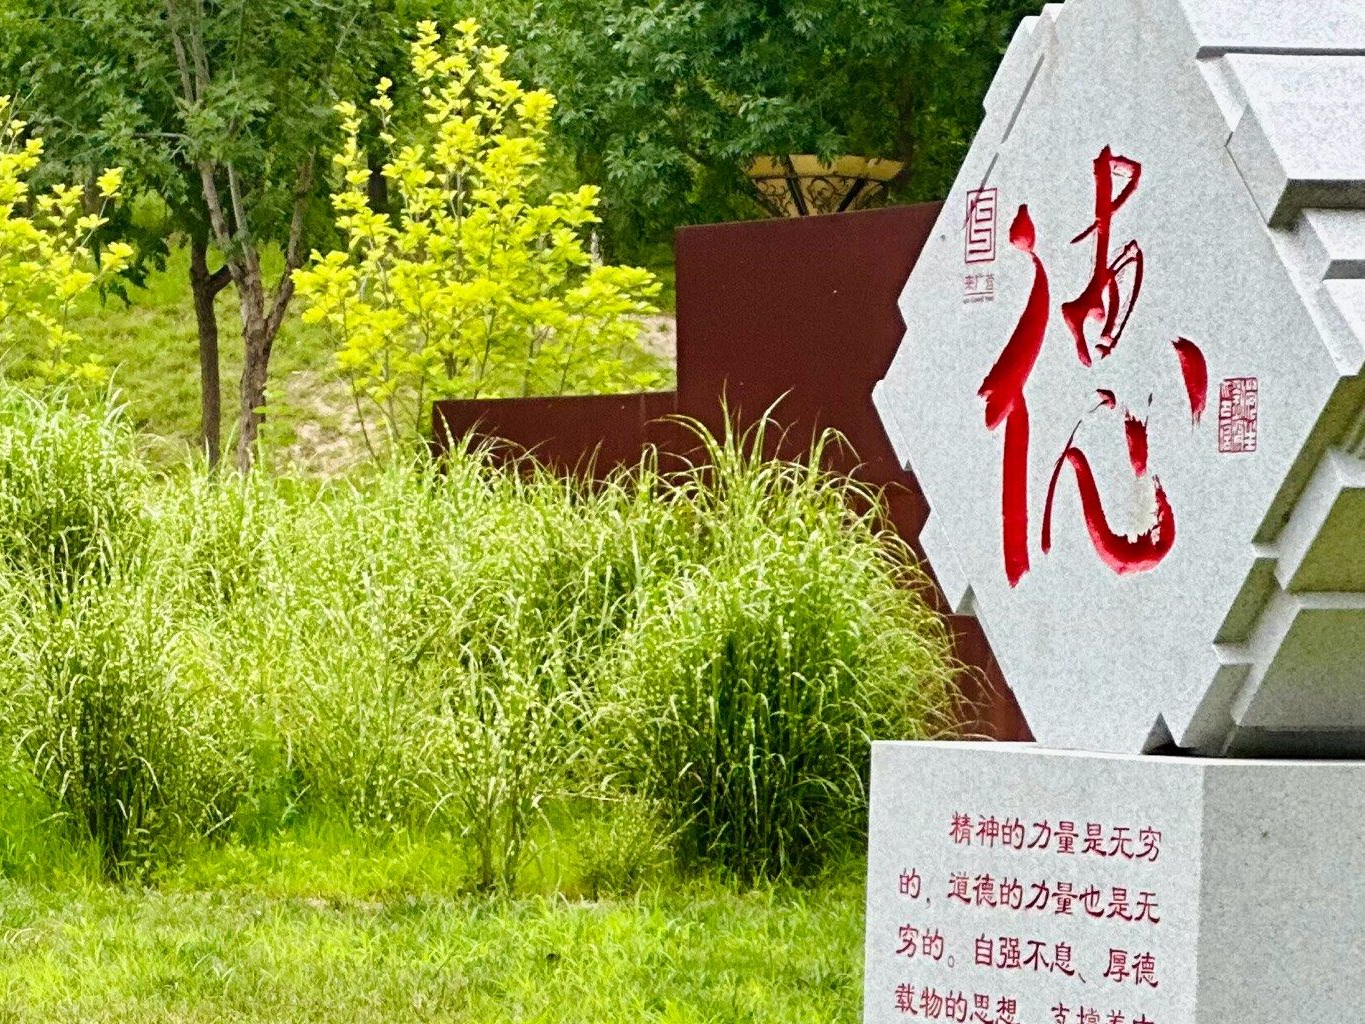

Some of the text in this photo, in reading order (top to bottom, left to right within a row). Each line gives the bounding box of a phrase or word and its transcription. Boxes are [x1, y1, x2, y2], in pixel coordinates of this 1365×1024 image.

[977, 144, 1208, 589] 德
[949, 810, 1162, 862] 精神的力量是无穷
[899, 867, 1161, 924] 的，道德的力量也是无
[895, 923, 1159, 988] 穷的。自强不息、厚德
